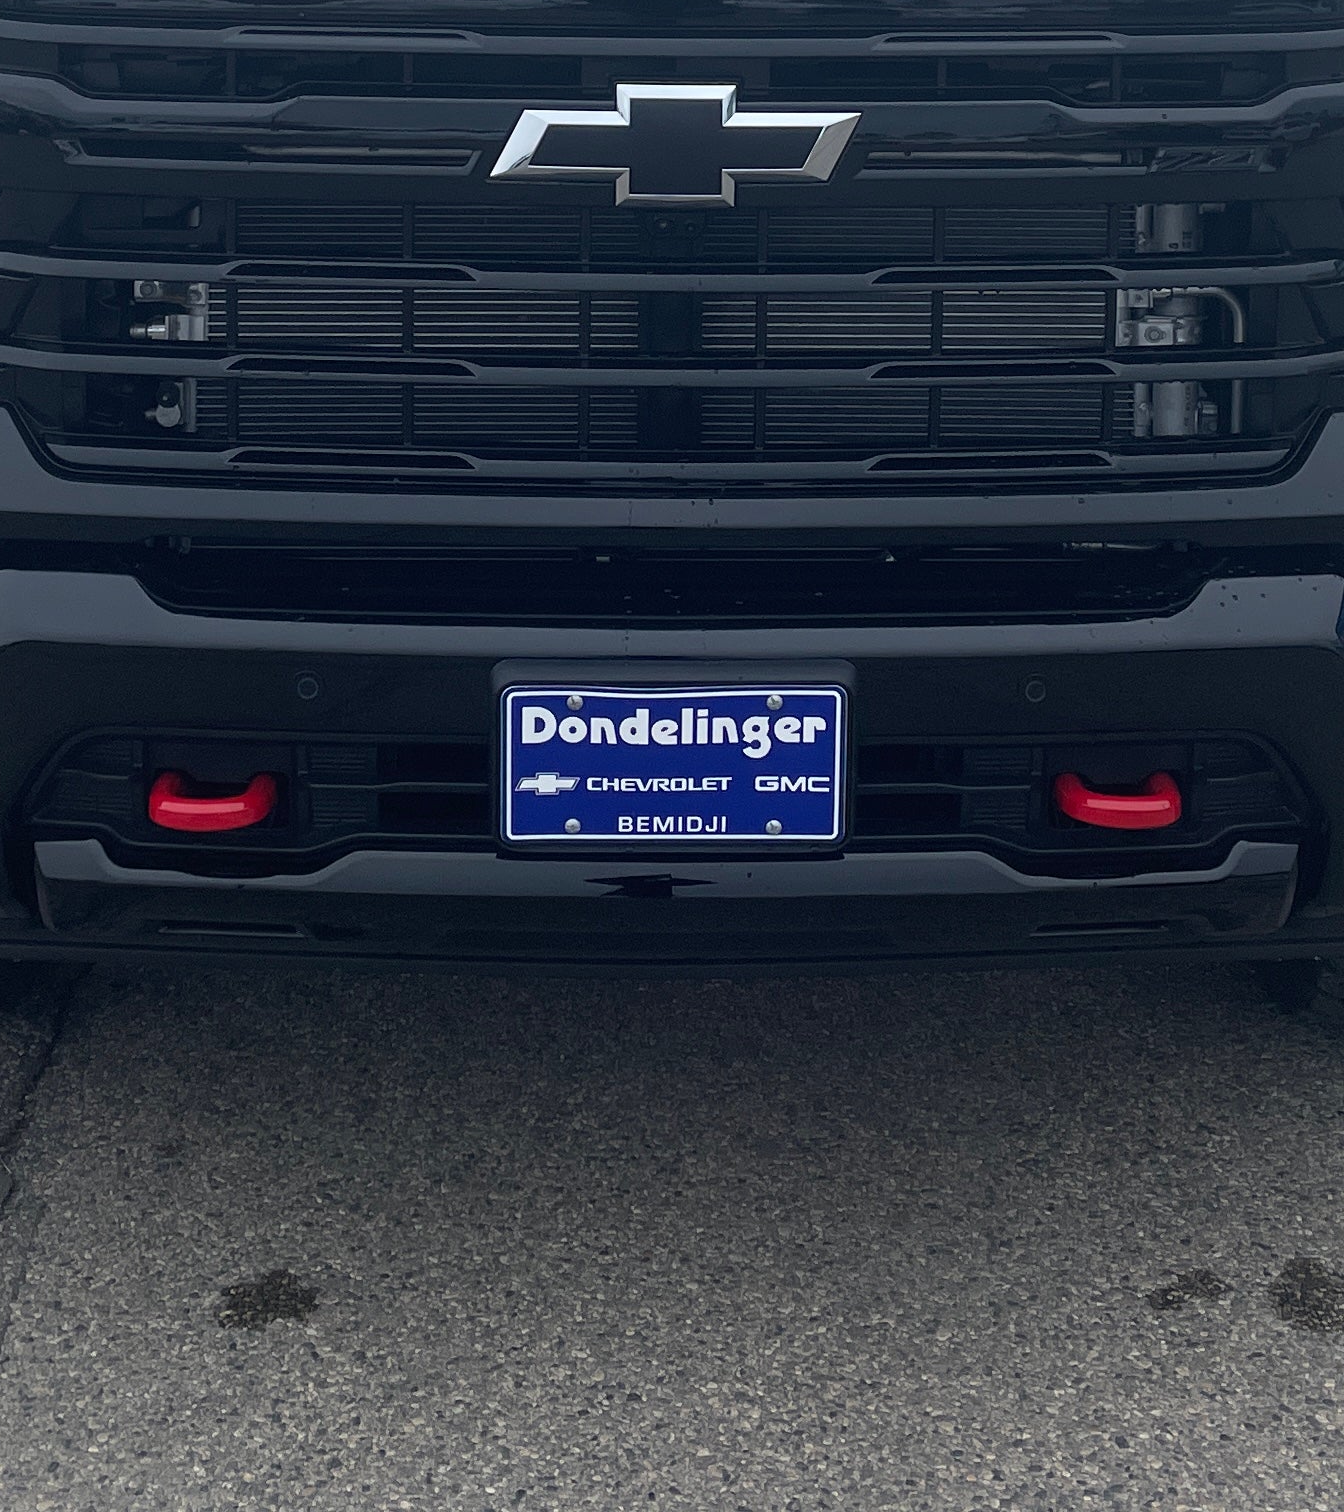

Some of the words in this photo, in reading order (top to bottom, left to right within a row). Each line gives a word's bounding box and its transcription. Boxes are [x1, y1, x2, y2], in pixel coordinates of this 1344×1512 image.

[521, 706, 827, 759] Dondelinger
[586, 777, 733, 792] CHEVROLET
[755, 776, 830, 792] GMC
[618, 816, 727, 833] BEMIDJI
